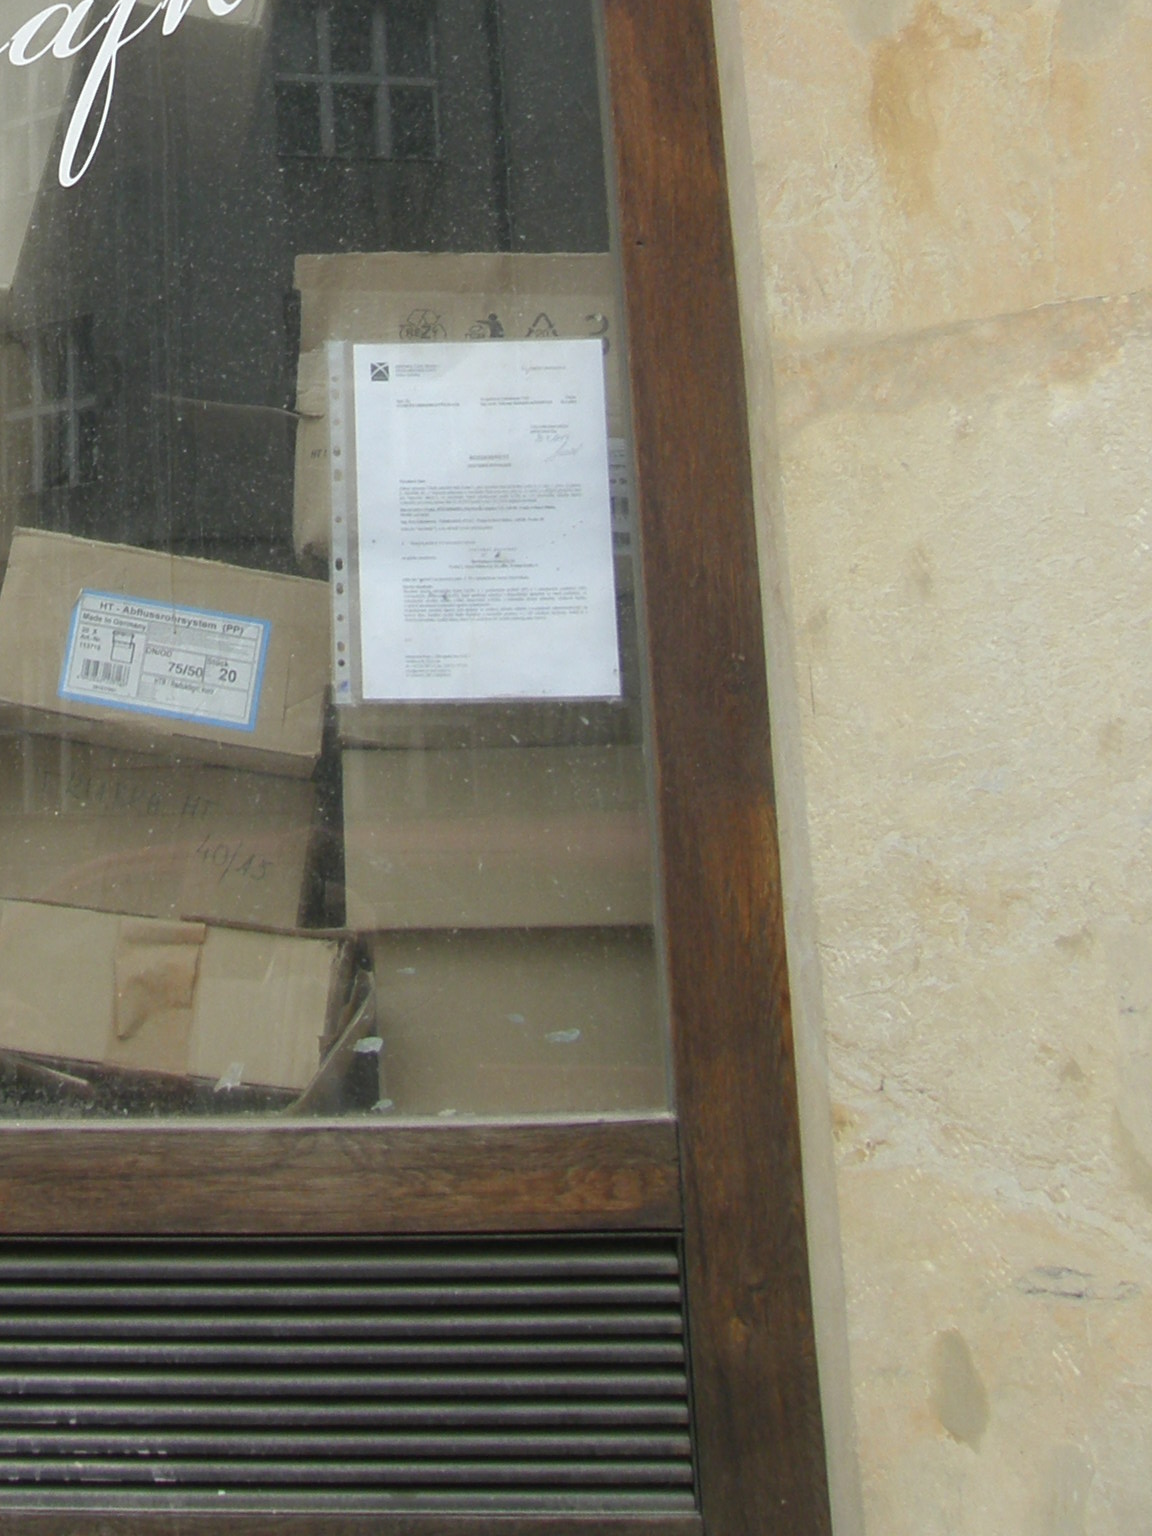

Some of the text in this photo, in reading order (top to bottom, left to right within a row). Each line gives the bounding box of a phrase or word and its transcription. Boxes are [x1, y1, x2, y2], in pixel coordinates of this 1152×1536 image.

[82, 612, 102, 622] Made
[113, 618, 146, 632] Germany
[100, 601, 114, 611] HT
[222, 623, 245, 637] (PP)
[168, 661, 203, 678] 75/50
[219, 667, 237, 683] 20
